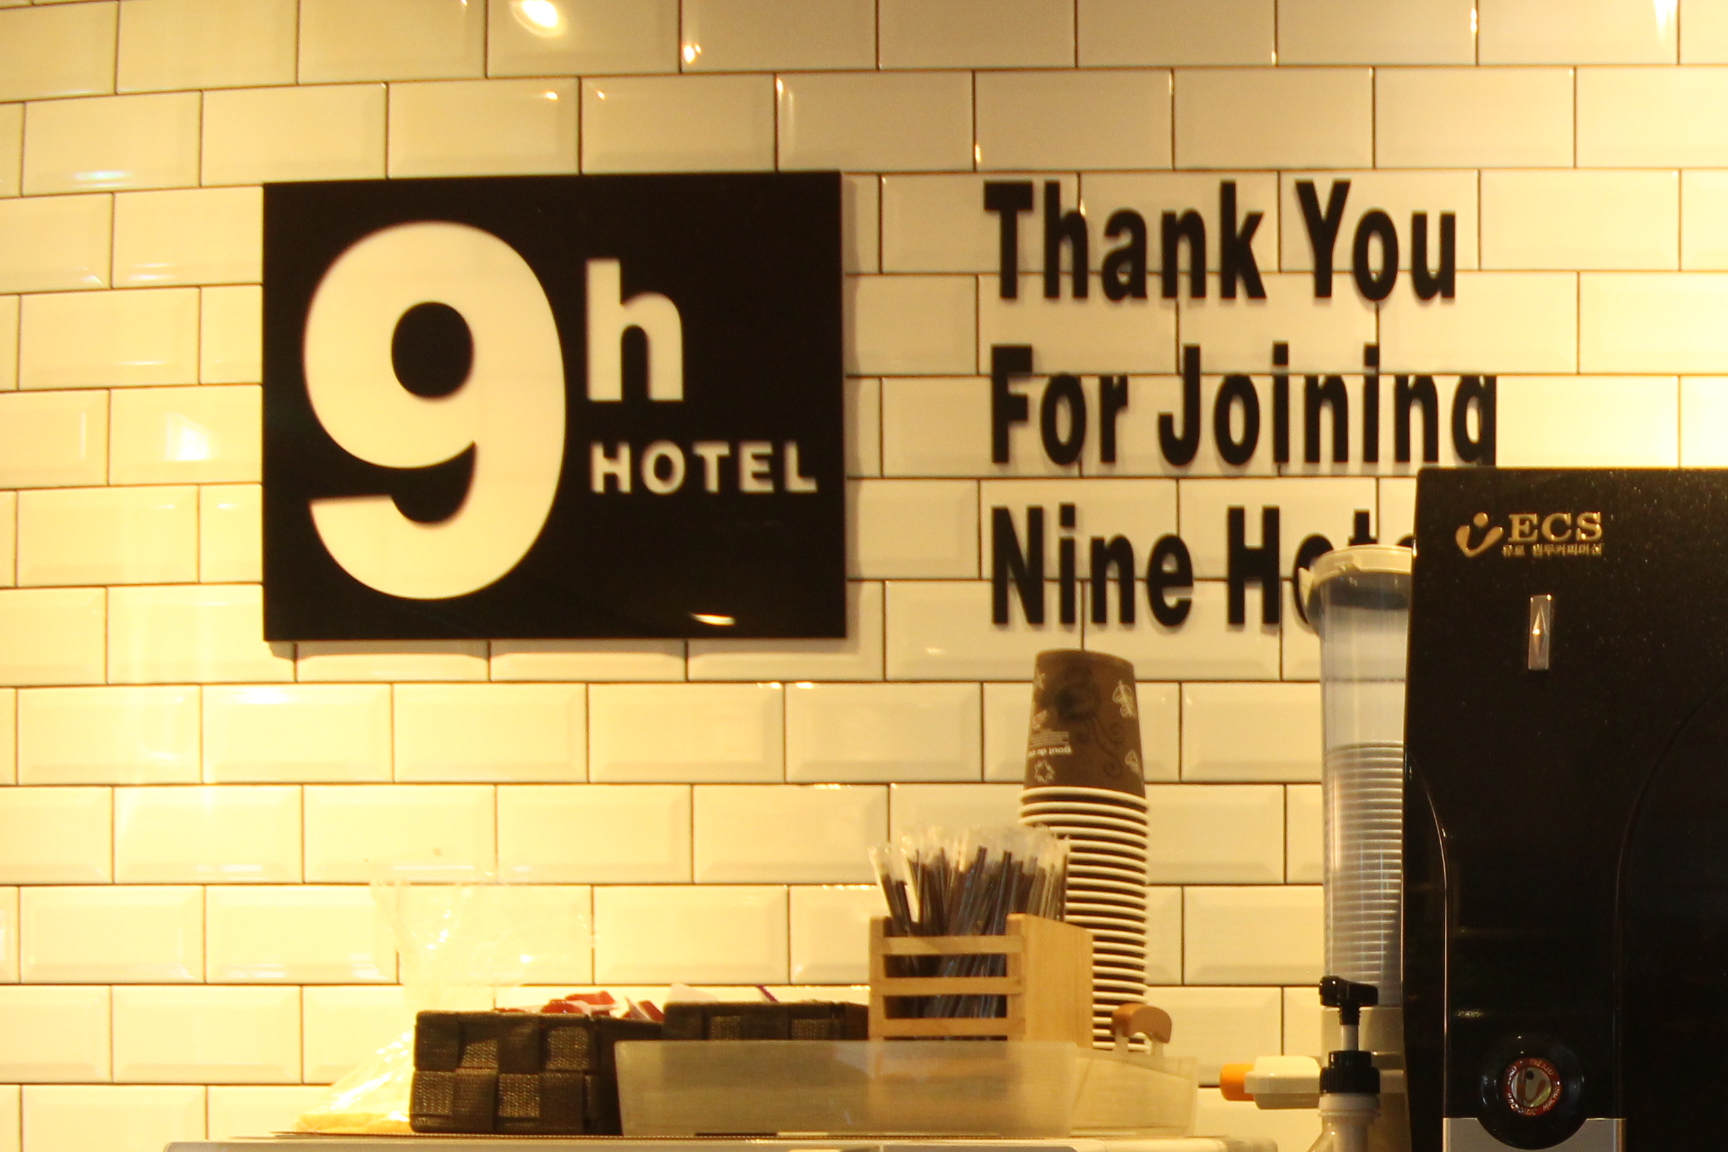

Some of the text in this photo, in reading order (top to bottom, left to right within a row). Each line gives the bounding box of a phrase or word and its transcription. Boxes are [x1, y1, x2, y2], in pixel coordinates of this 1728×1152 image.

[983, 180, 1457, 302] Thank You
[585, 258, 684, 402] h
[304, 219, 566, 600] 9
[990, 340, 1498, 467] For Joining
[589, 440, 818, 495] HOTEL
[1507, 511, 1603, 543] ECS
[991, 503, 1194, 627] Nine
